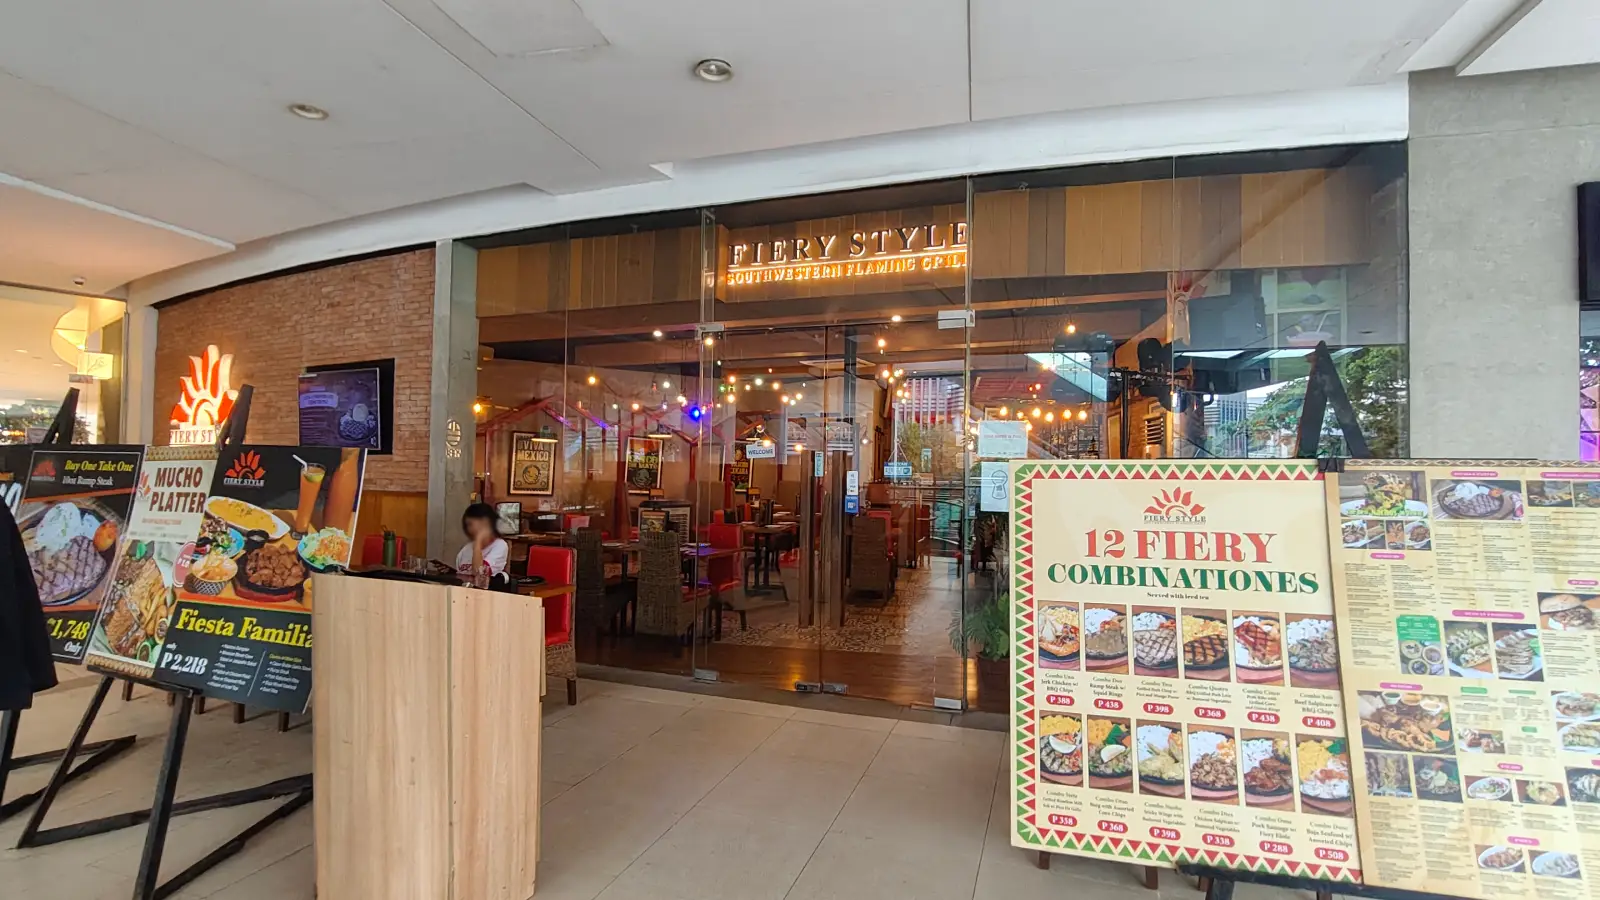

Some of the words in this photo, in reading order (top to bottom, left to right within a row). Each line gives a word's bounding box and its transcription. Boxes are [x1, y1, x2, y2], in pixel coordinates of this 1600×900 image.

[728, 235, 837, 267] FIERY
[727, 264, 841, 285] SOUTHWESTERN
[846, 256, 916, 276] FLAMING
[516, 450, 549, 461] MEXICO
[65, 460, 80, 473] Buy
[81, 461, 97, 471] One
[98, 461, 116, 471] Take
[117, 461, 134, 472] One
[154, 466, 203, 488] MUCHO
[149, 491, 207, 513] PLATTER
[1084, 529, 1126, 558] 12
[1134, 529, 1277, 563] FIERY
[1047, 562, 1320, 594] COMBINATIONES
[175, 608, 235, 637] Fiesta
[64, 641, 83, 656] Only
[1057, 697, 1071, 705] 388
[1110, 823, 1123, 832] 368
[1162, 830, 1176, 838] 398
[1215, 836, 1230, 845] 338
[1272, 844, 1288, 853] 288
[1328, 851, 1344, 859] 508
